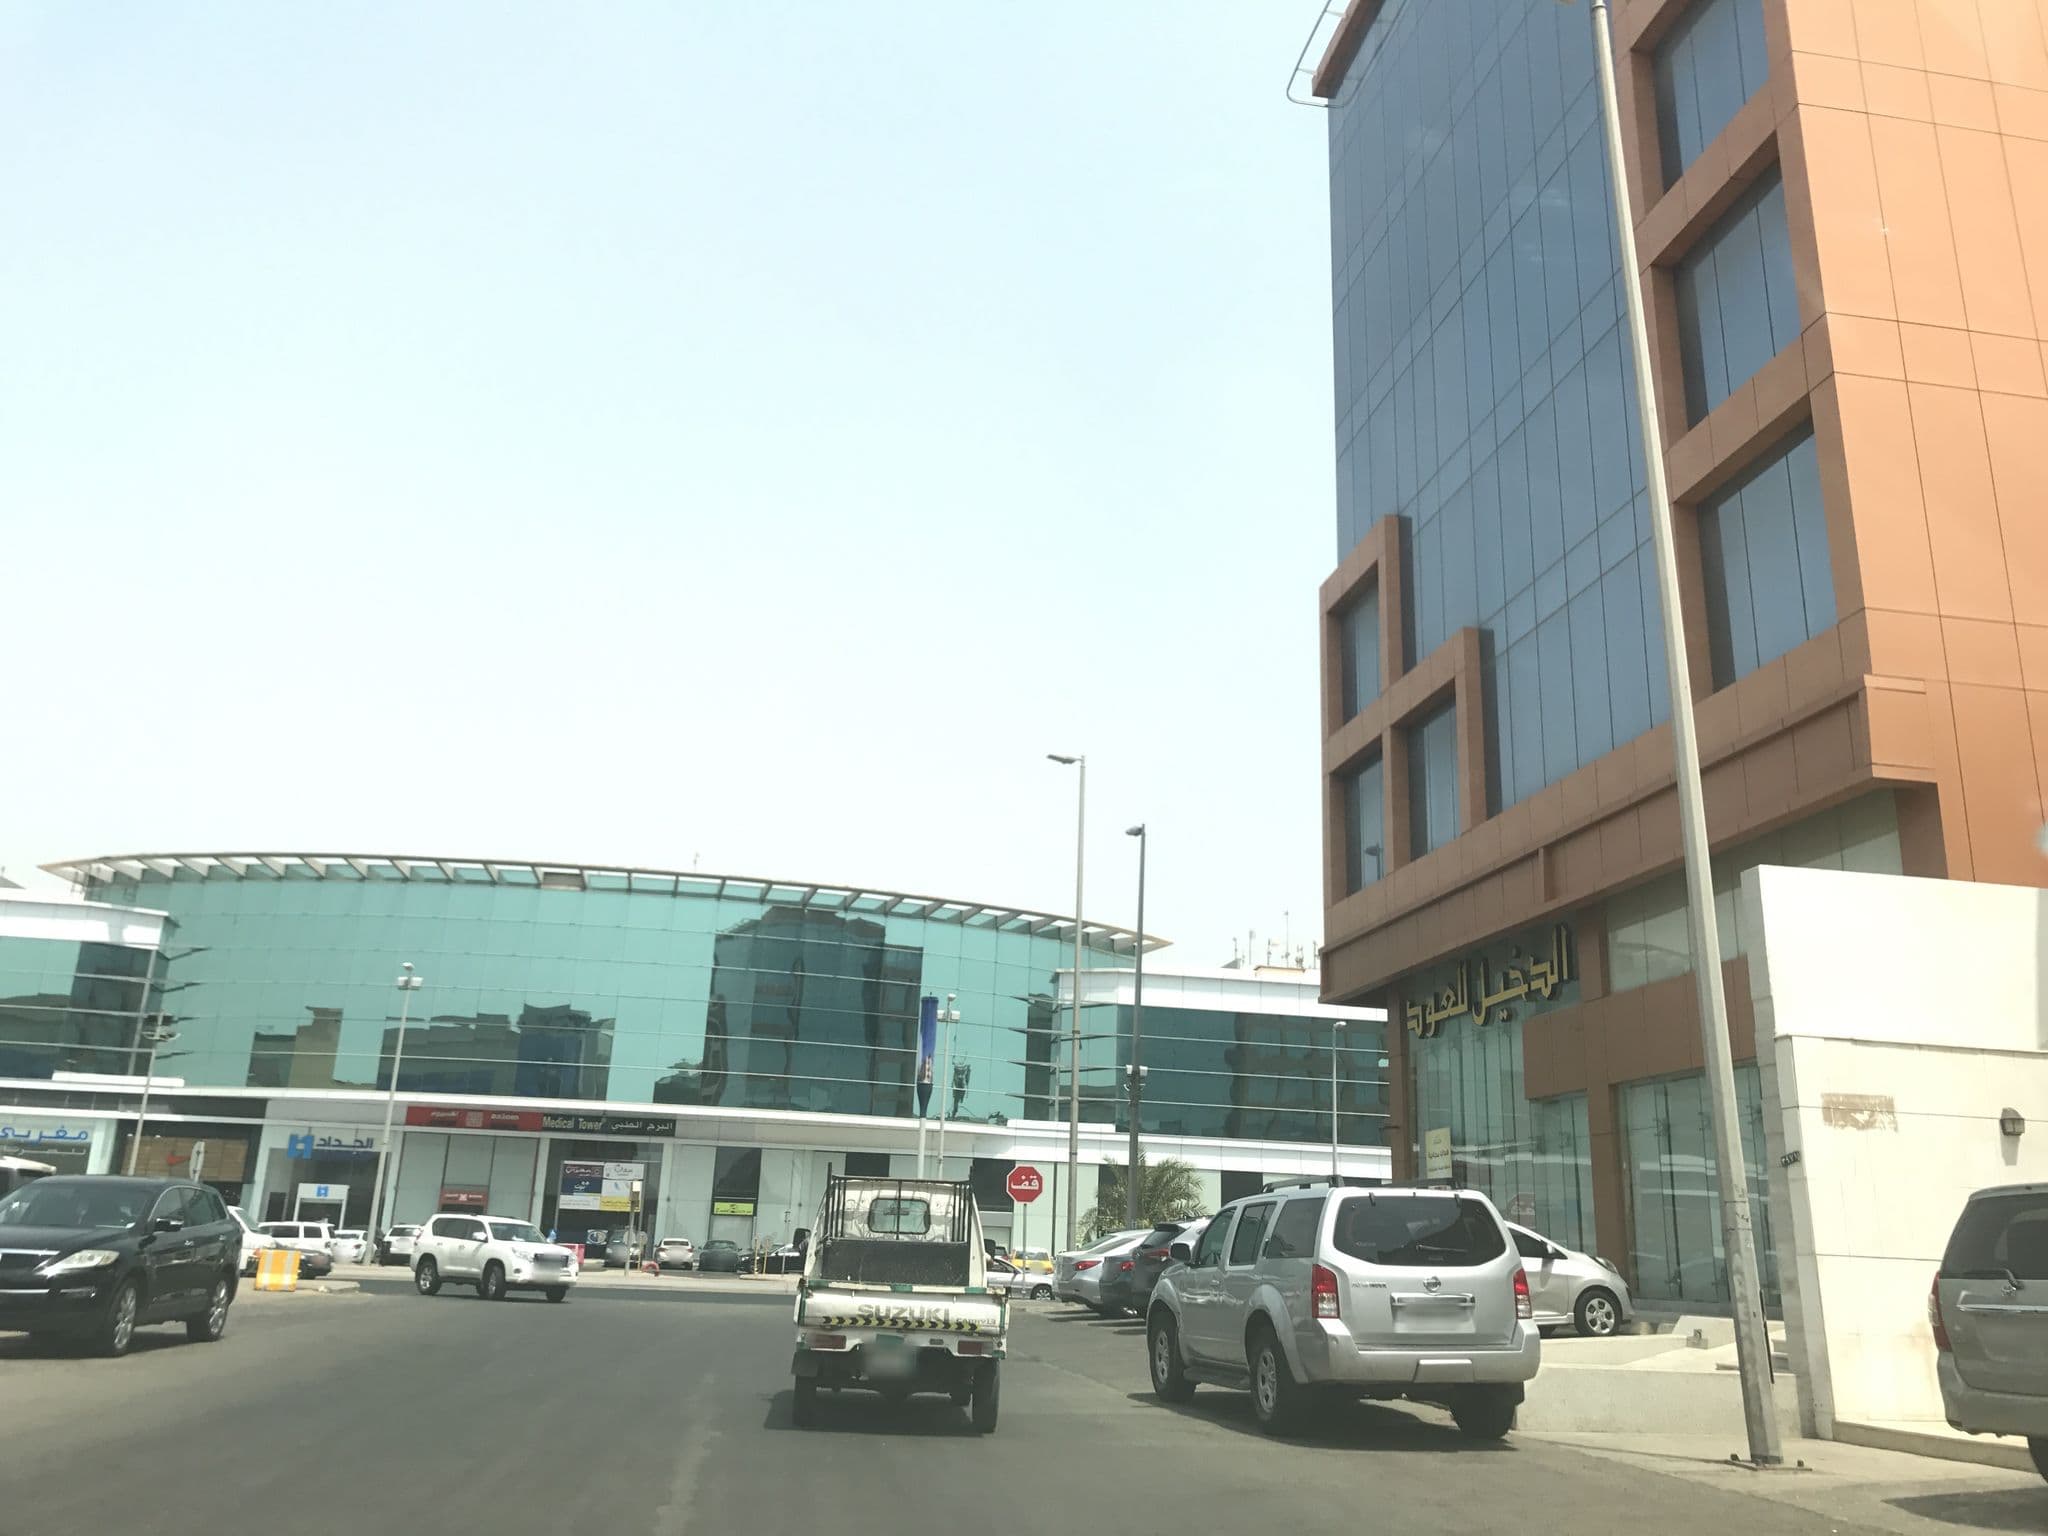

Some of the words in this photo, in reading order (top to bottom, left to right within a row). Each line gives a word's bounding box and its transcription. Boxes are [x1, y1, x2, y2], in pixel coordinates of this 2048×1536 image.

[1471, 923, 1570, 1027] الدخيل
[543, 1115, 574, 1129] Medical
[578, 1118, 603, 1130] Tower
[646, 1122, 673, 1132] البرج
[1010, 1175, 1039, 1190] قف
[857, 1303, 950, 1322] SUZUKI
